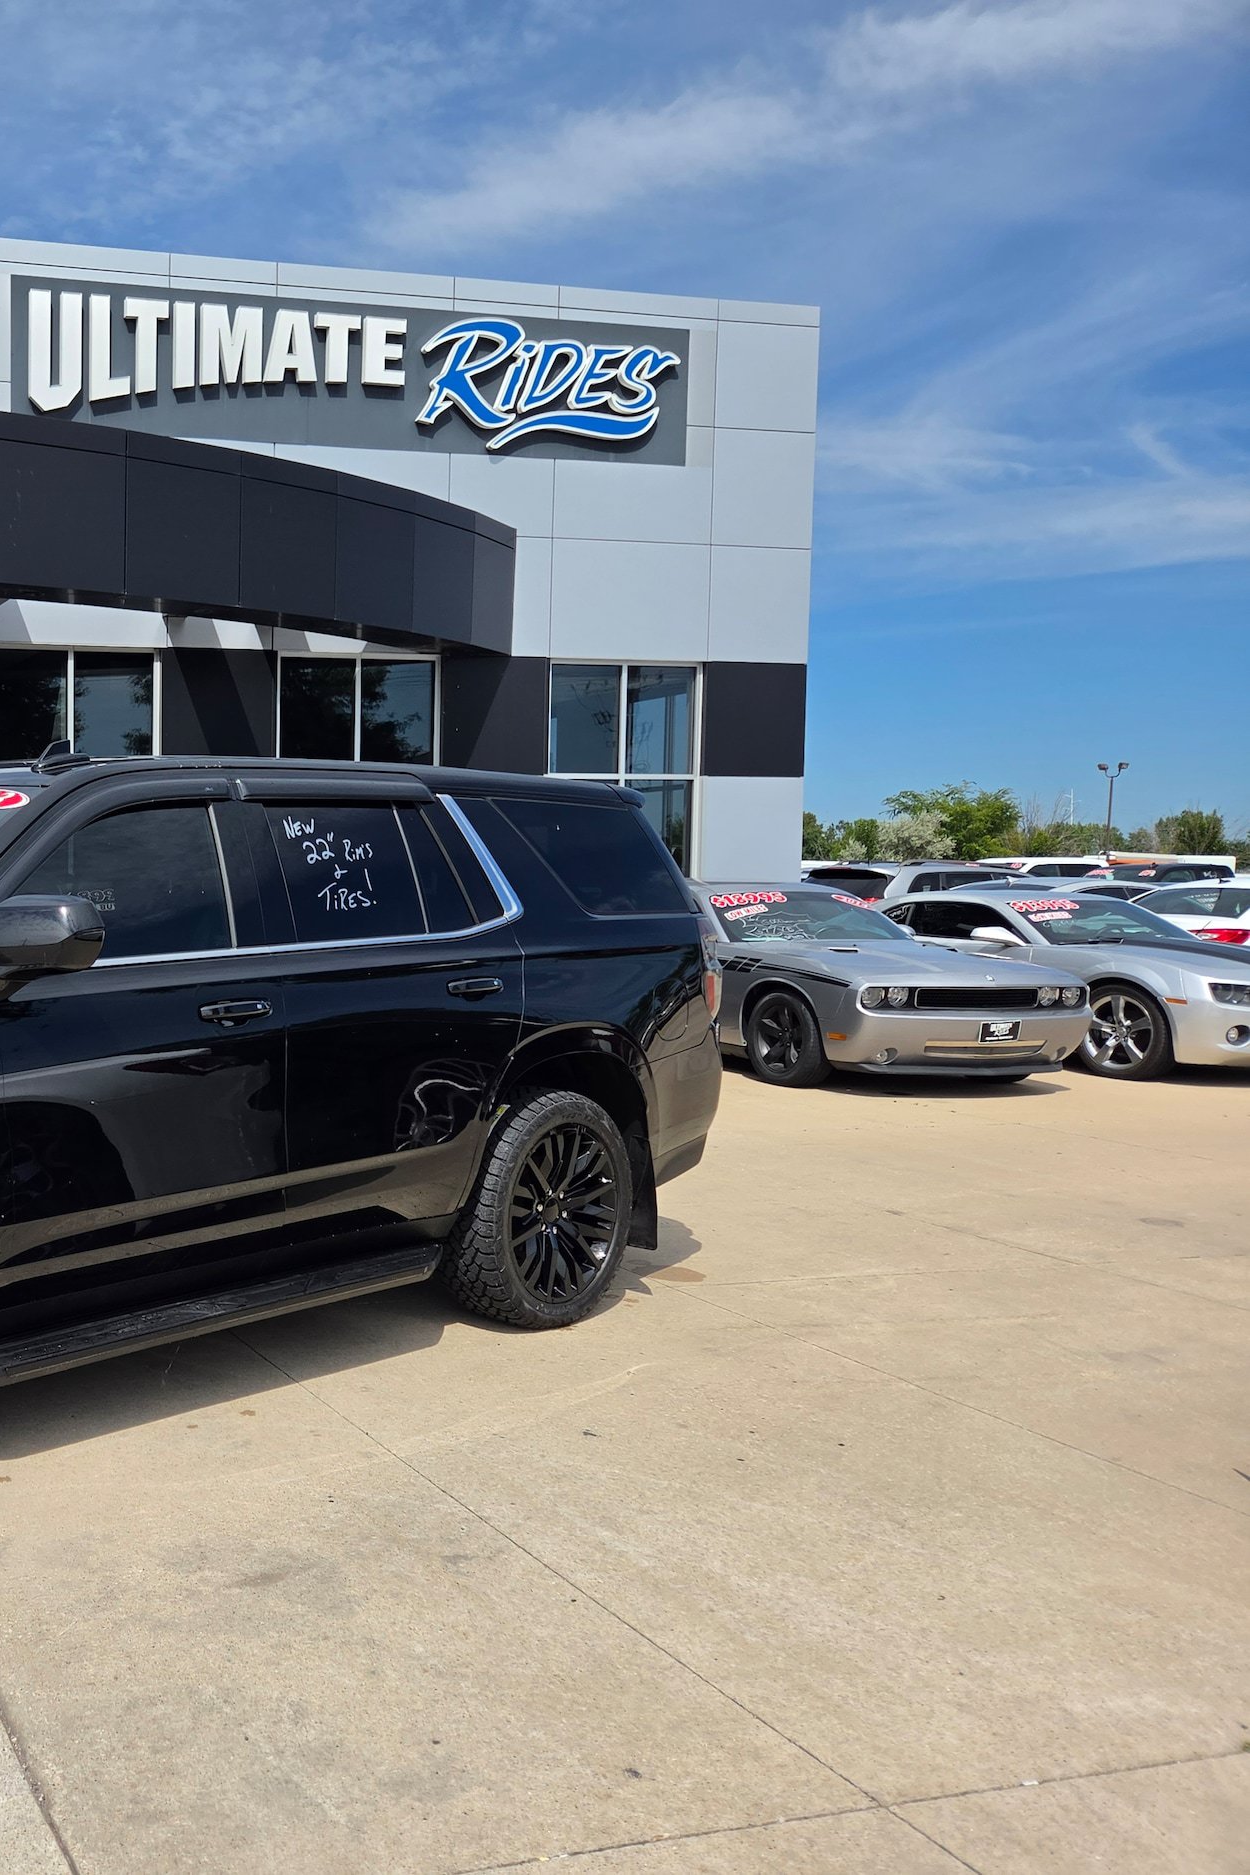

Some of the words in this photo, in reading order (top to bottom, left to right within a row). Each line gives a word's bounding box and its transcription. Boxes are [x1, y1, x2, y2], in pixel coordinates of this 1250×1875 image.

[28, 288, 408, 412] ULTIMATE
[711, 892, 787, 908] $18995
[726, 909, 744, 920] LOW
[744, 904, 768, 915] MILES
